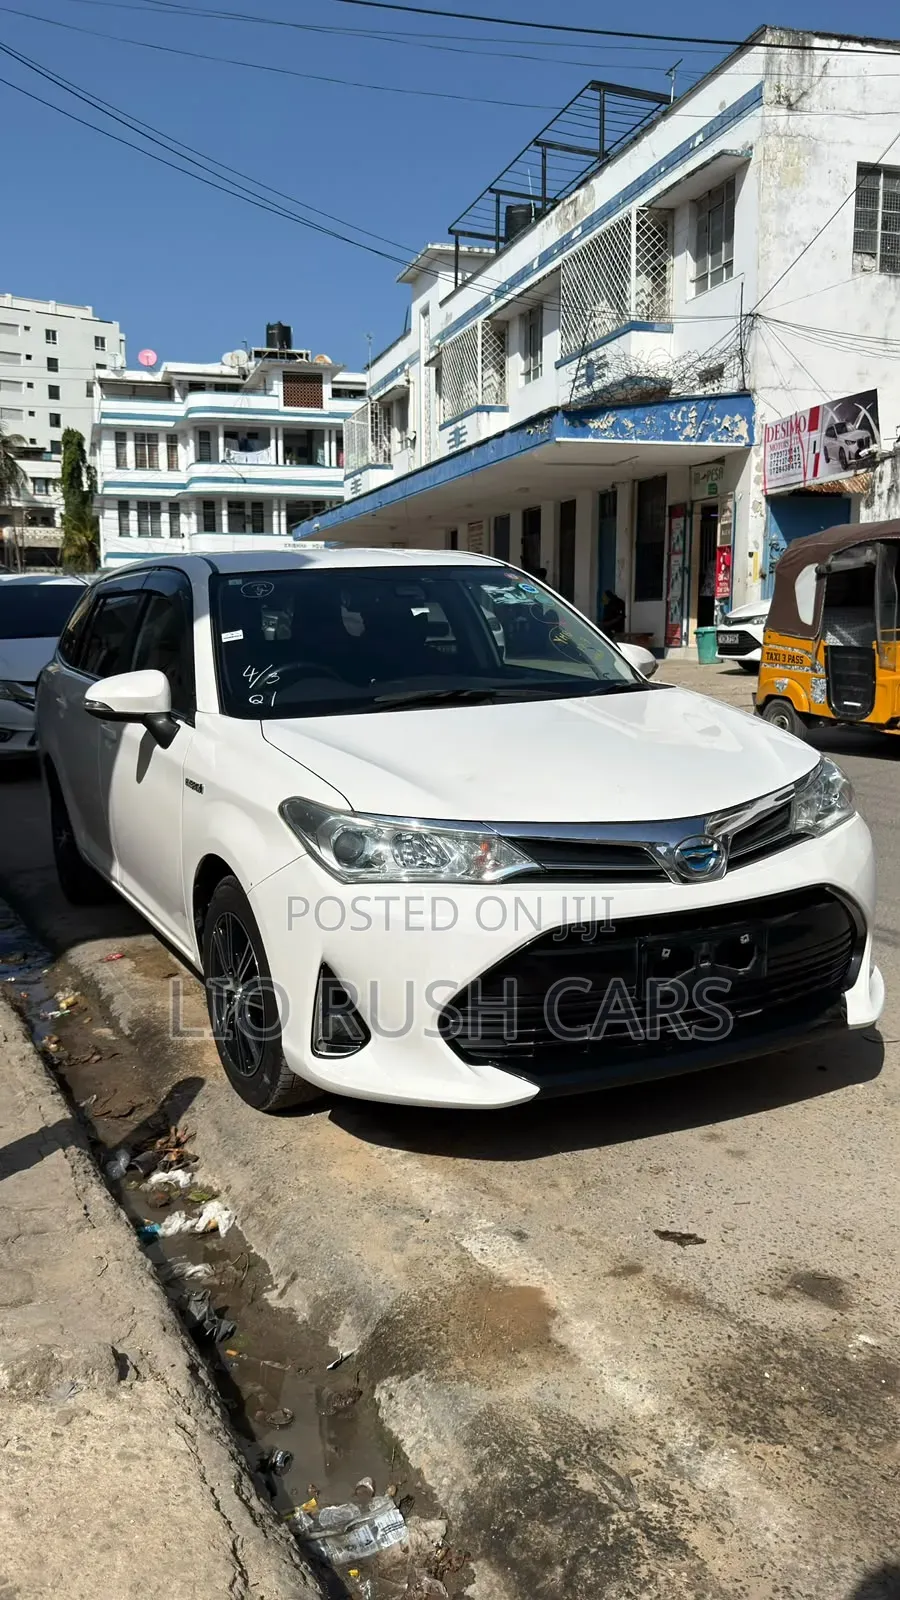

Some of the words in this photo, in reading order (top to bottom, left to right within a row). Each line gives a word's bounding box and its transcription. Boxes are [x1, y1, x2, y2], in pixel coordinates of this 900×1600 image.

[767, 415, 806, 443] DESIMO
[766, 651, 780, 662] TAXI
[782, 653, 787, 663] 3
[787, 654, 804, 665] PASS
